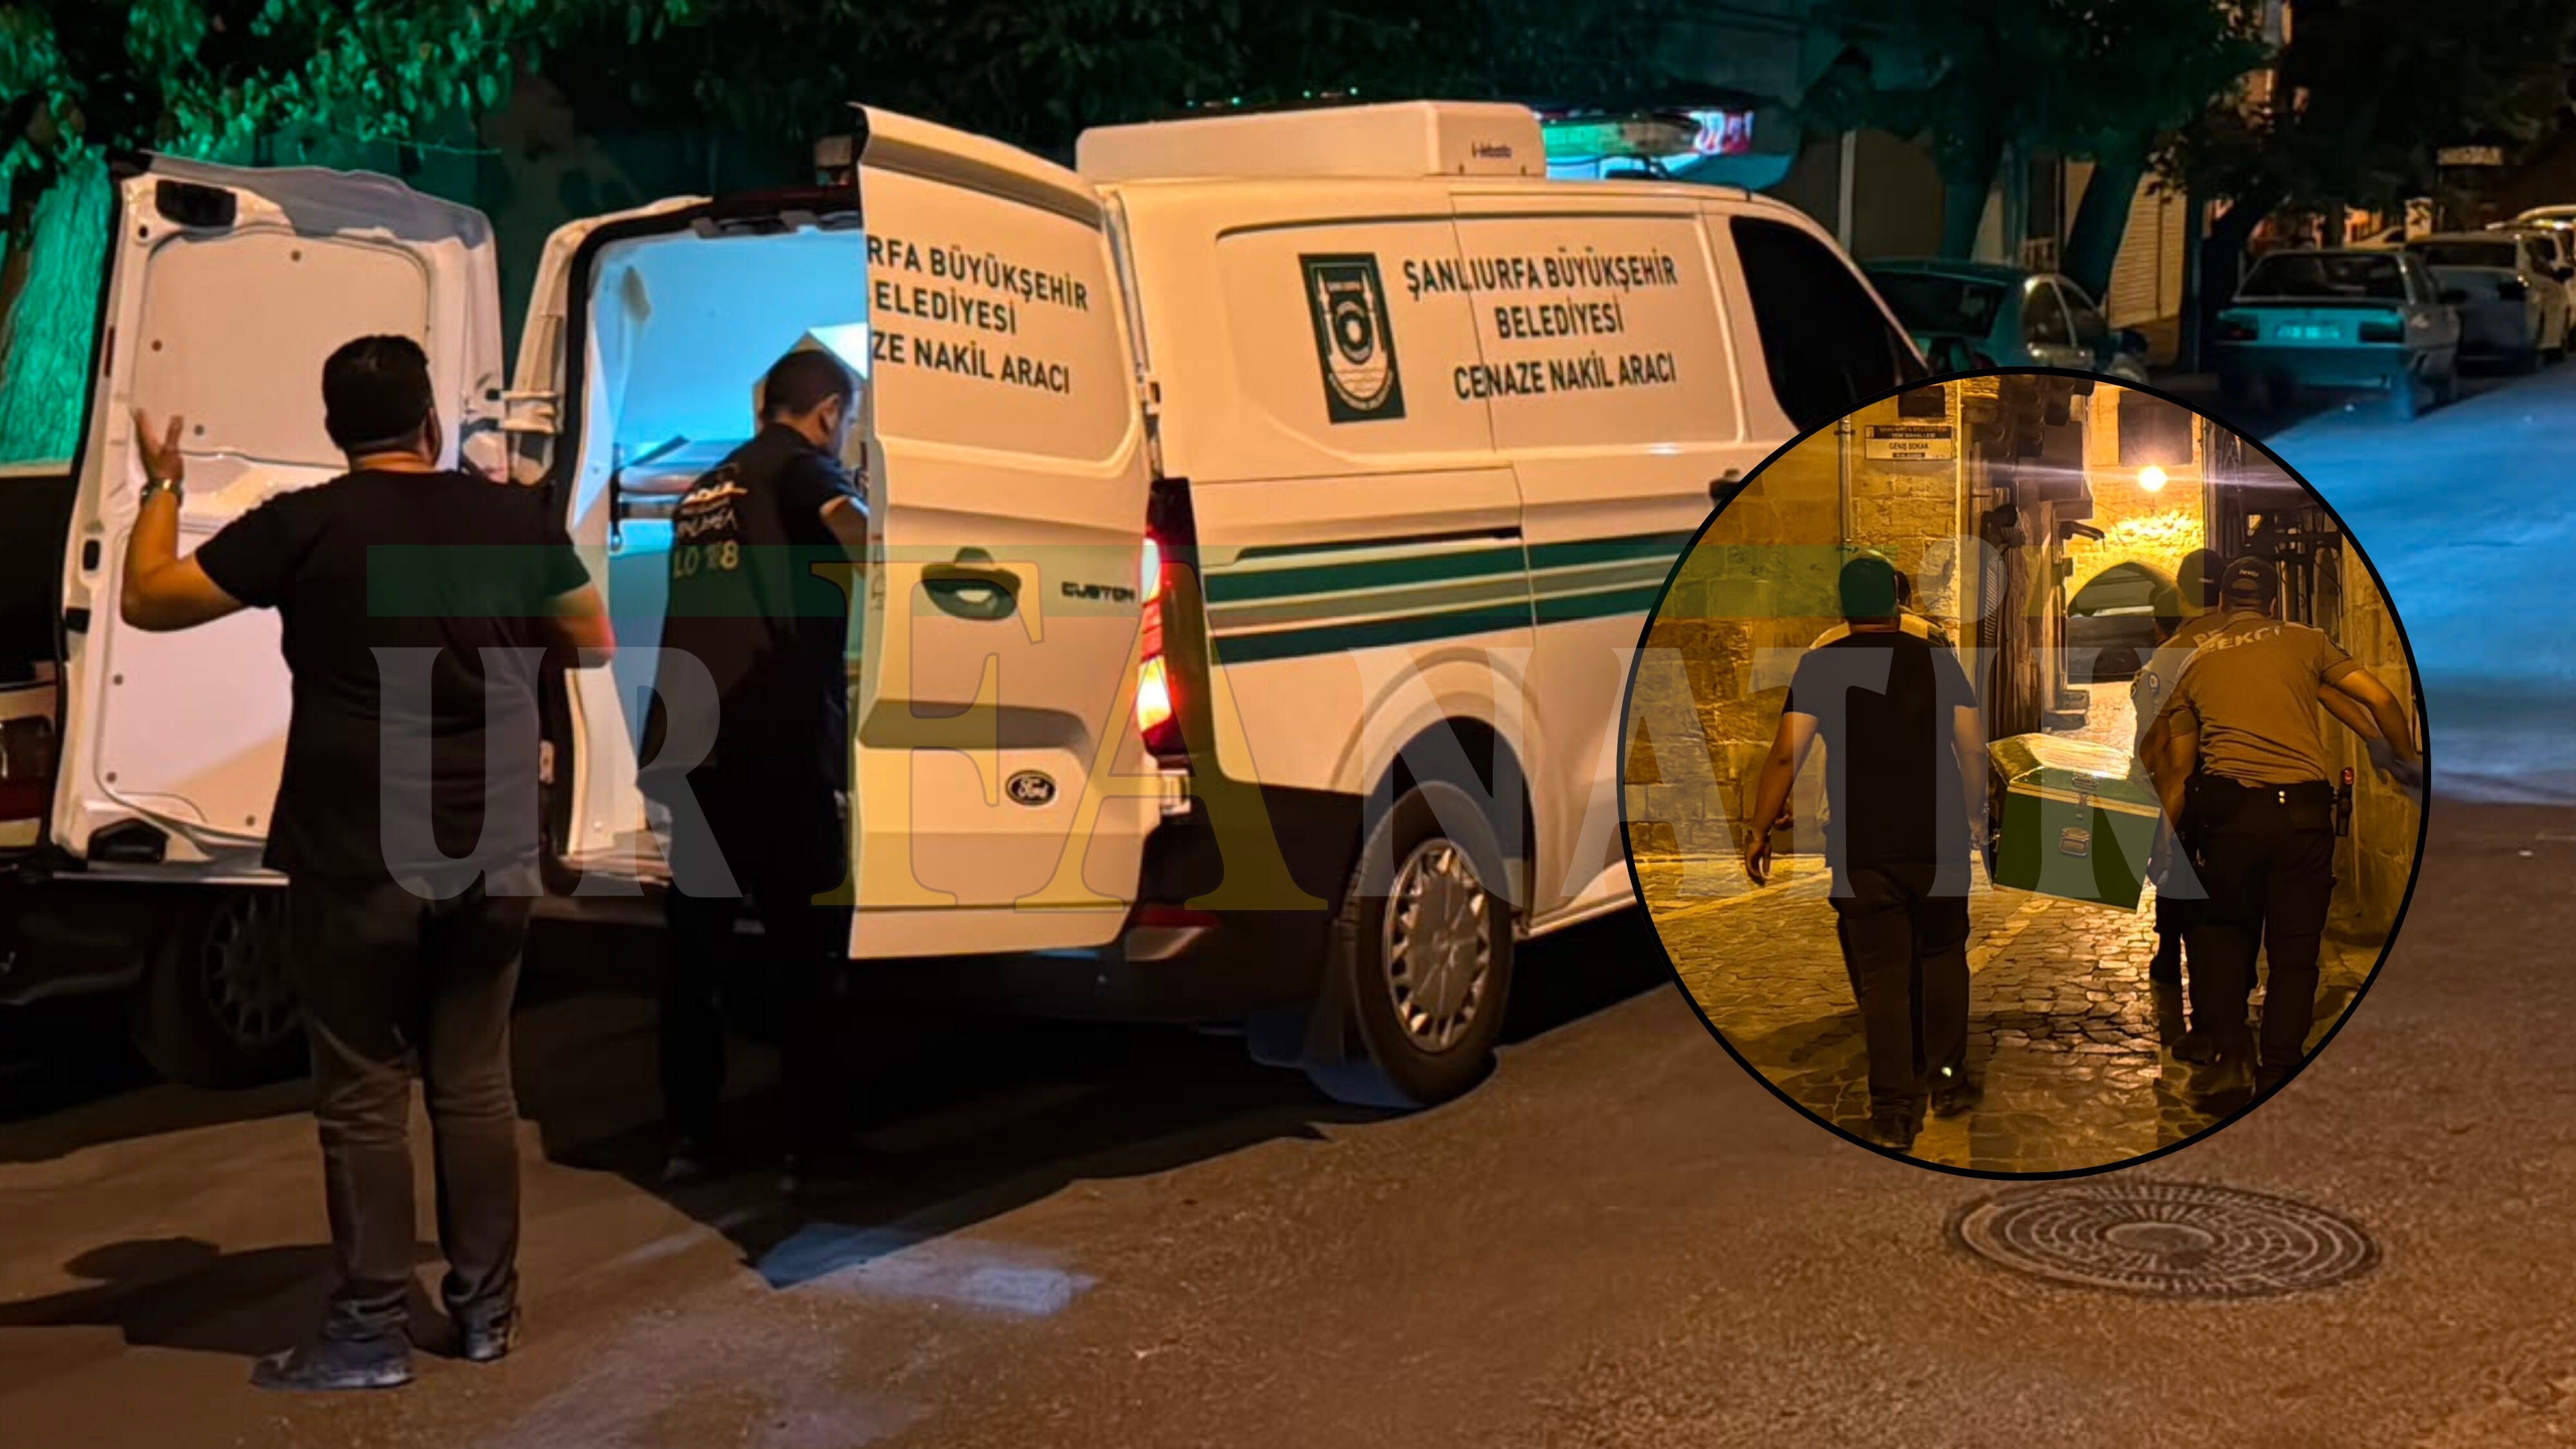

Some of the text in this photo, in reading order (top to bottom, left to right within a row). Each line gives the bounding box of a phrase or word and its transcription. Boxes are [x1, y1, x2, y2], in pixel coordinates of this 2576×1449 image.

[929, 245, 1088, 312] BÜYÜKŞEHİR
[1403, 246, 1678, 302] ŞANLIURFA BÜYÜKŞEHİR
[869, 279, 1017, 334] ELEDİYESİ
[1494, 294, 1624, 339] BELEDİYESİ
[914, 337, 994, 379] NAKİL
[1000, 354, 1070, 394] ARACI
[1454, 349, 1677, 400] CENAZE NAKİL ARACI
